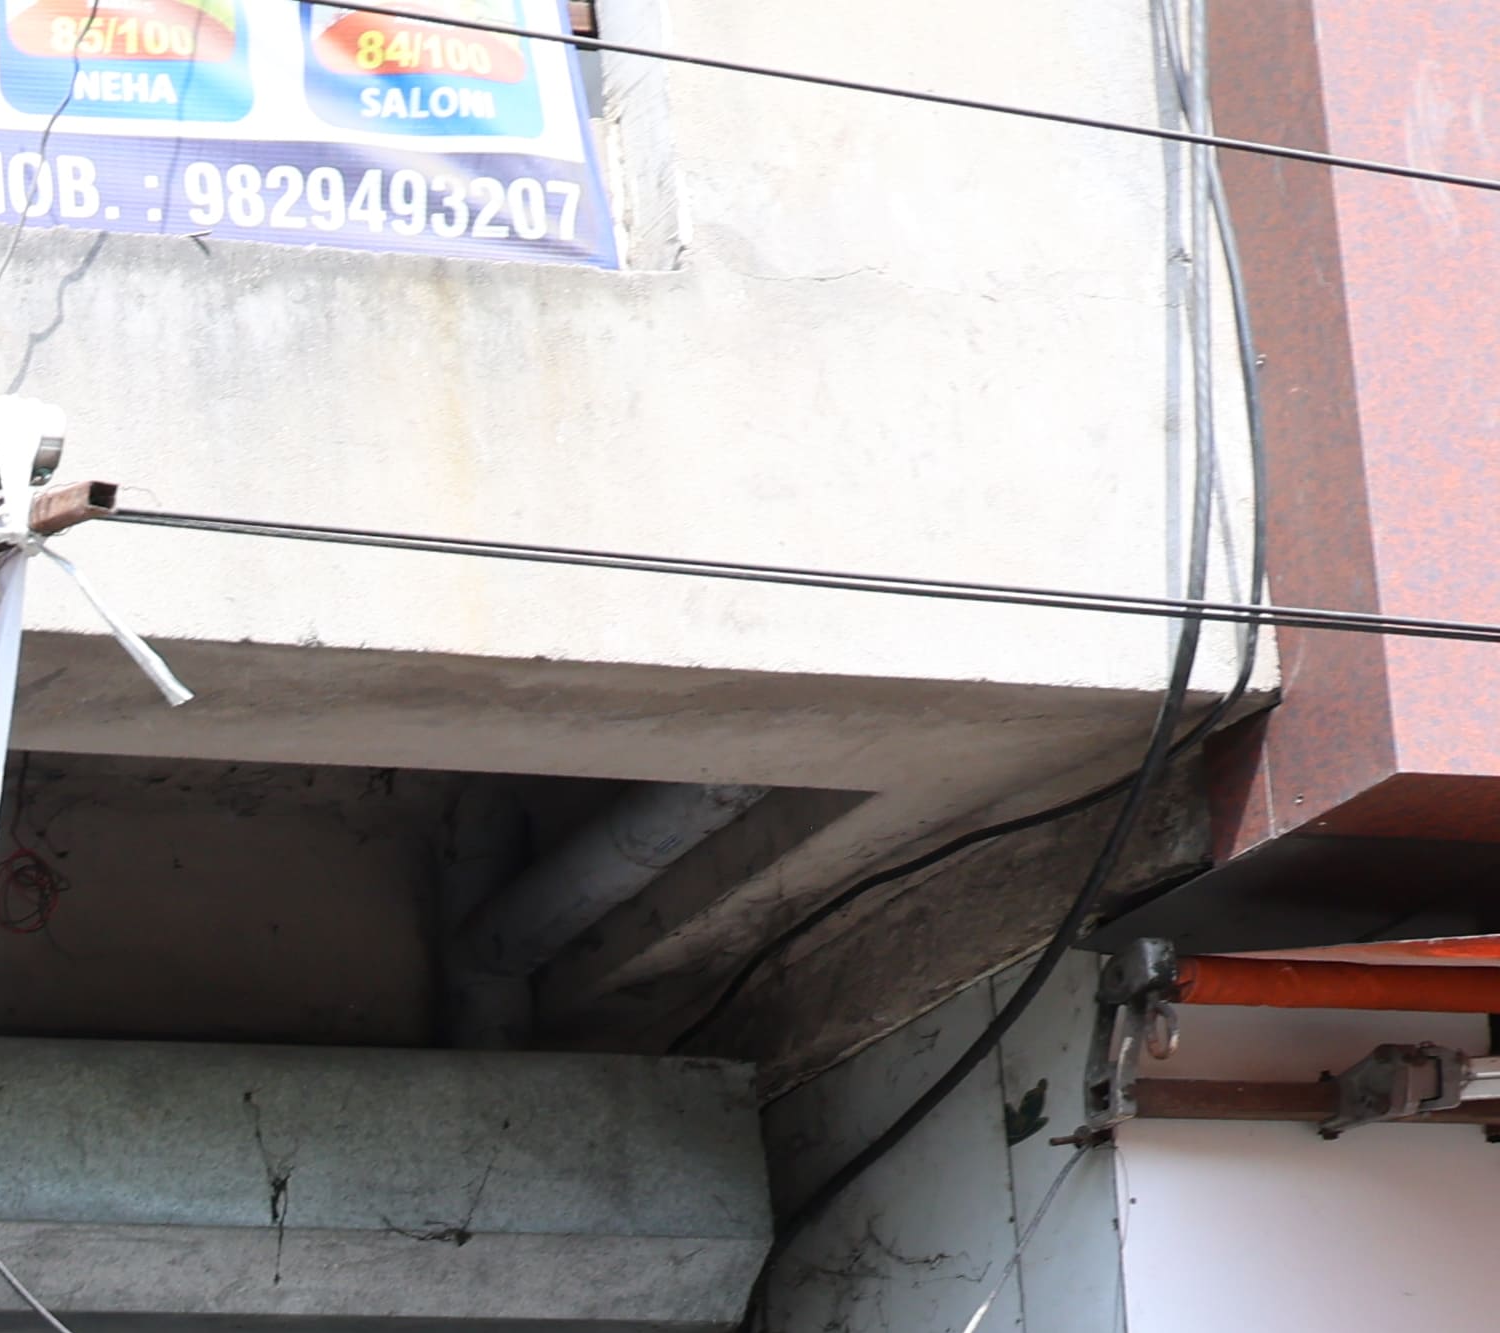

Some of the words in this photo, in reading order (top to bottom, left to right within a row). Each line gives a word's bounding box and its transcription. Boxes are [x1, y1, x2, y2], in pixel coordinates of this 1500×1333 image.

[50, 12, 196, 58] 85/100
[356, 28, 493, 75] 84/100
[73, 69, 178, 104] NEHA
[360, 86, 496, 120] SALONI
[182, 160, 581, 242] 9829493207
